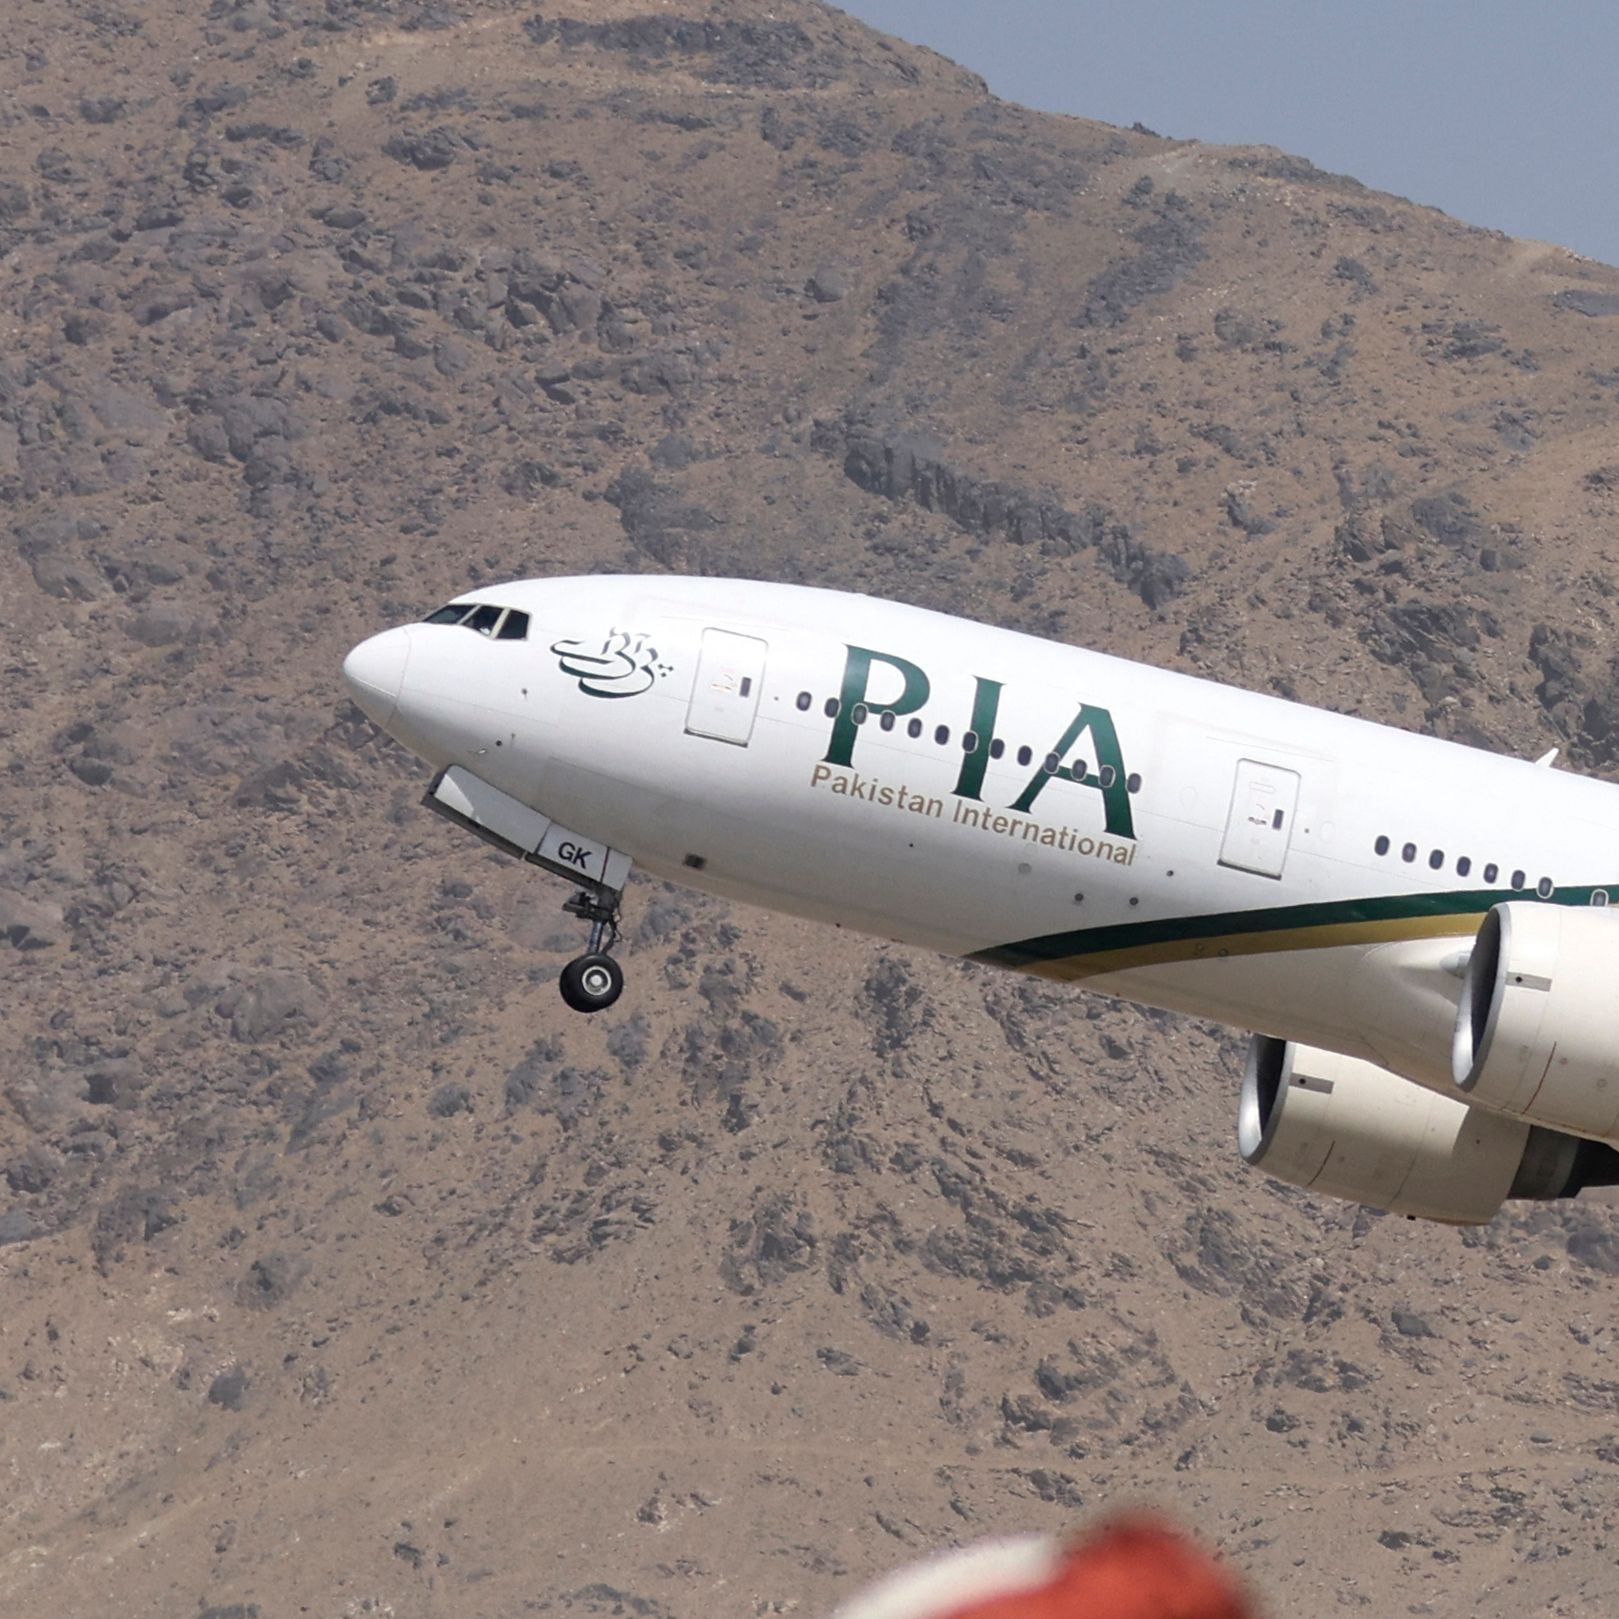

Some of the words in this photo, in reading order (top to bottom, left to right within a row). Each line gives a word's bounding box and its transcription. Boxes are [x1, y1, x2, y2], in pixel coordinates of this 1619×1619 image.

[821, 643, 1138, 840] PIA
[558, 842, 592, 870] GK
[810, 763, 943, 819] Pakistan
[952, 799, 1137, 867] International
